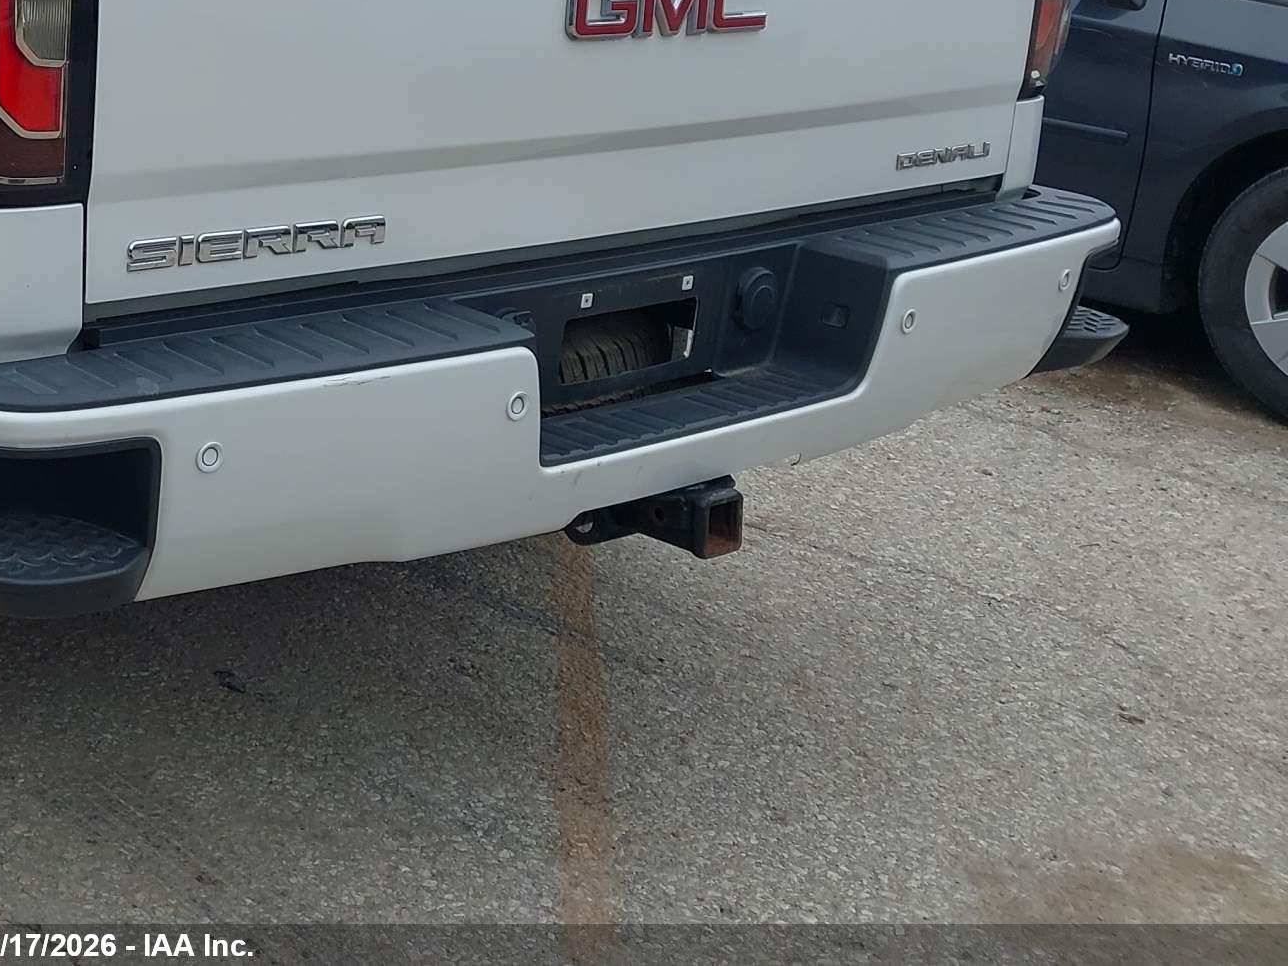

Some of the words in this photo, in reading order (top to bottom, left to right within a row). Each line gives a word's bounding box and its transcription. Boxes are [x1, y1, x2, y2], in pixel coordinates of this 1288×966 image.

[1168, 53, 1233, 75] HYBRID
[896, 141, 991, 171] DENALI
[127, 214, 386, 272] SIERRA
